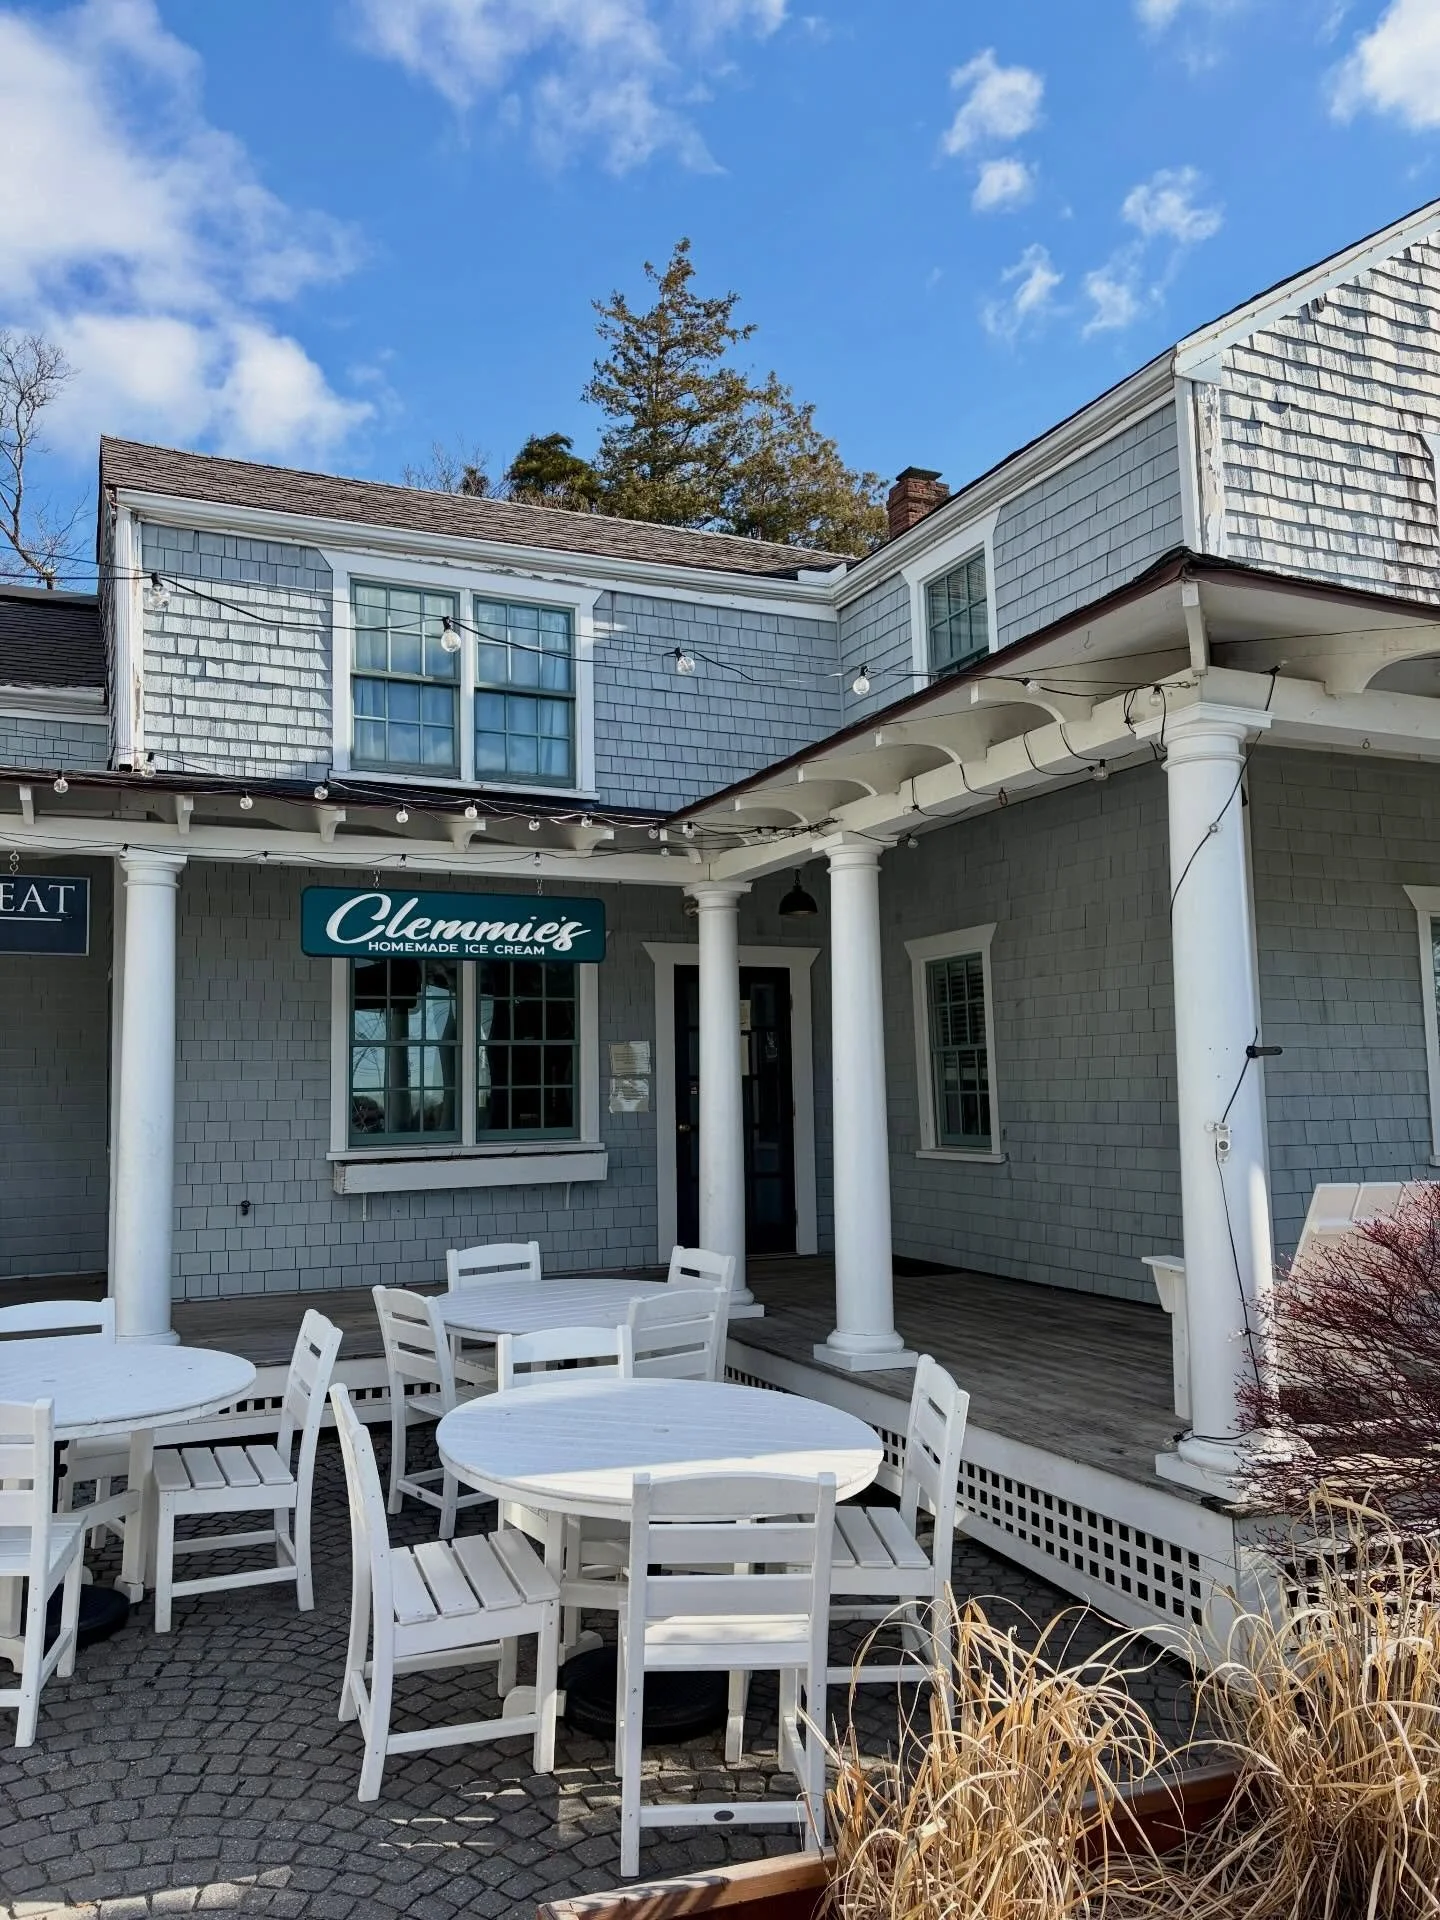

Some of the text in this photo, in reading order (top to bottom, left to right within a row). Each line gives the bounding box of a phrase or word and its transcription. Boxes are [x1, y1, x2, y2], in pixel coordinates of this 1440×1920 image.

[326, 893, 591, 951] Clemmie's
[368, 941, 545, 955] HOMEMADE ICE CREAM
